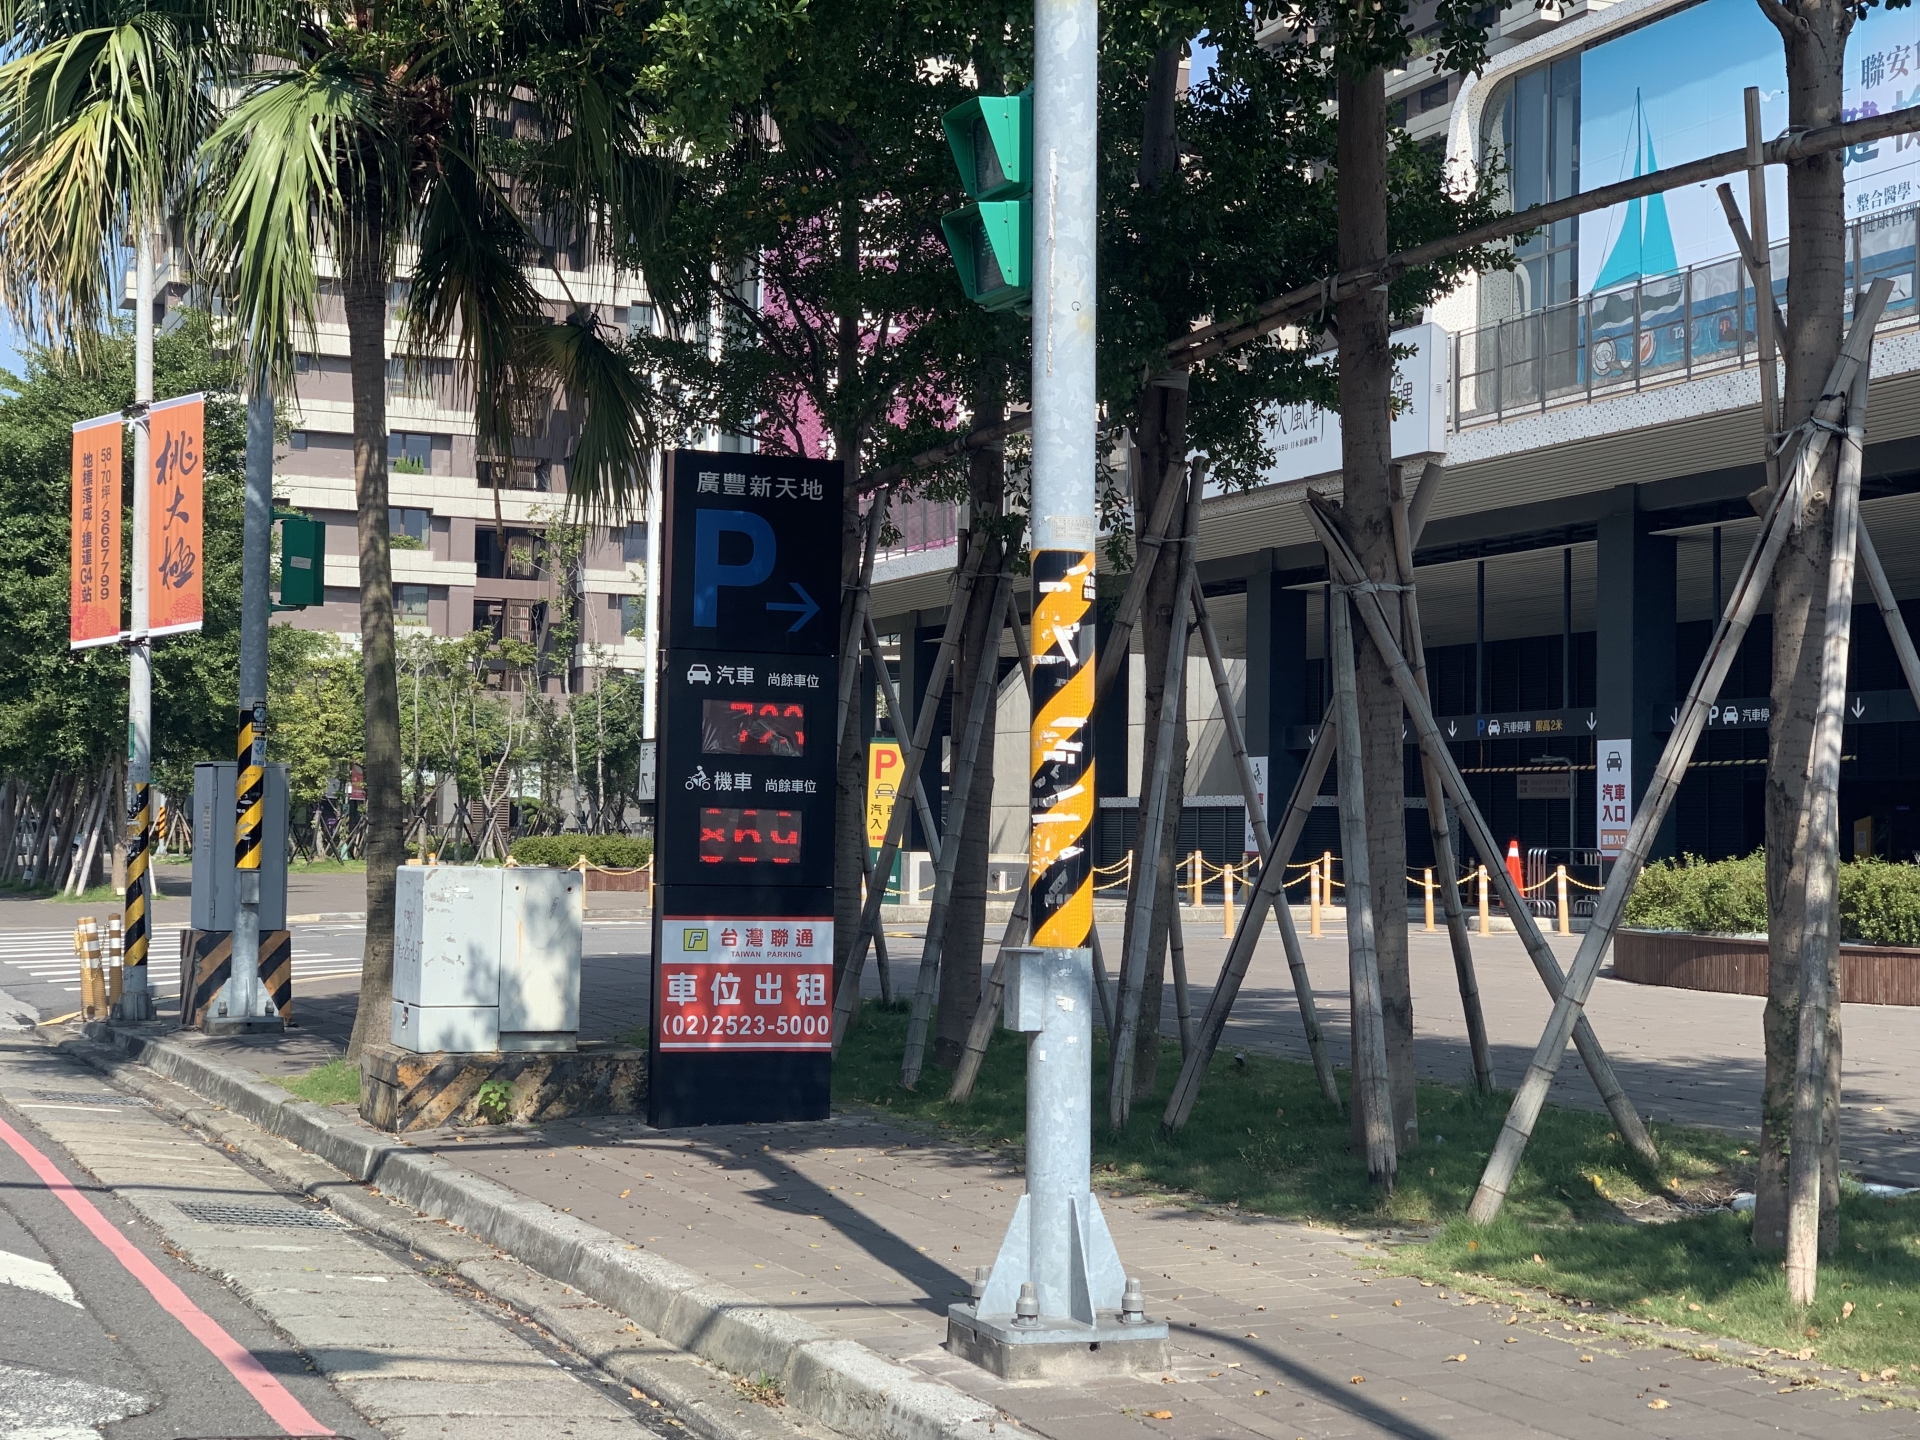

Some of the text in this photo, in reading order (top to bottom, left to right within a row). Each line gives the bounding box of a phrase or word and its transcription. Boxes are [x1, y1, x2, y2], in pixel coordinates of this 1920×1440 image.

[696, 471, 824, 501] 廣豐新天地
[693, 508, 777, 628] P
[716, 665, 820, 689] 汽車 尚餘車位
[1503, 720, 1532, 734] 汽車停車
[1535, 719, 1563, 733] 限高2米
[875, 749, 897, 780] P
[714, 772, 817, 794] 機車 尚餘車位
[1602, 783, 1626, 802] 汽車
[1602, 805, 1626, 823] 入口
[720, 927, 814, 948] 台灣聯通
[666, 971, 827, 1007] 車位出租
[662, 1014, 830, 1036] (02)2523-5000
